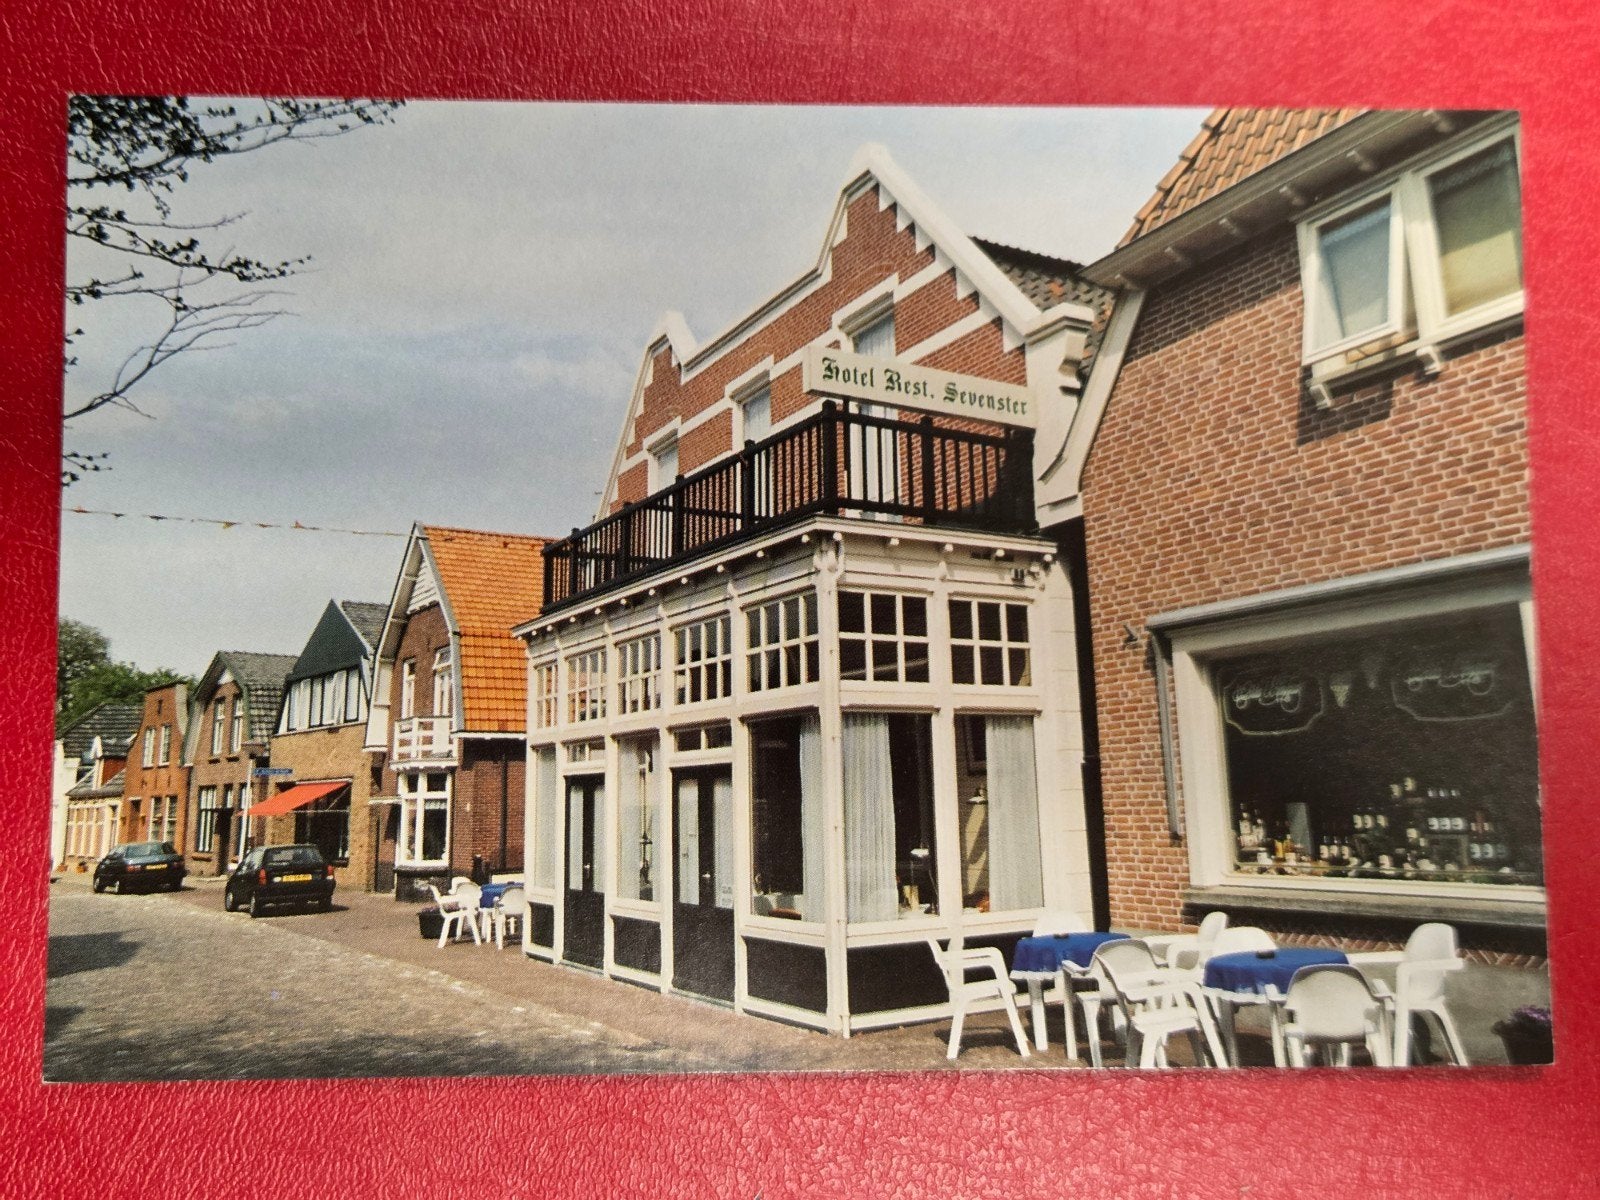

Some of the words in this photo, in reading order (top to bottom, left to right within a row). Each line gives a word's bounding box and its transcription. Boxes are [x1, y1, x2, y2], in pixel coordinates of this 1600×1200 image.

[822, 357, 874, 387] Hotel
[884, 368, 934, 397] Rest.
[943, 382, 1027, 415] Sevenster
